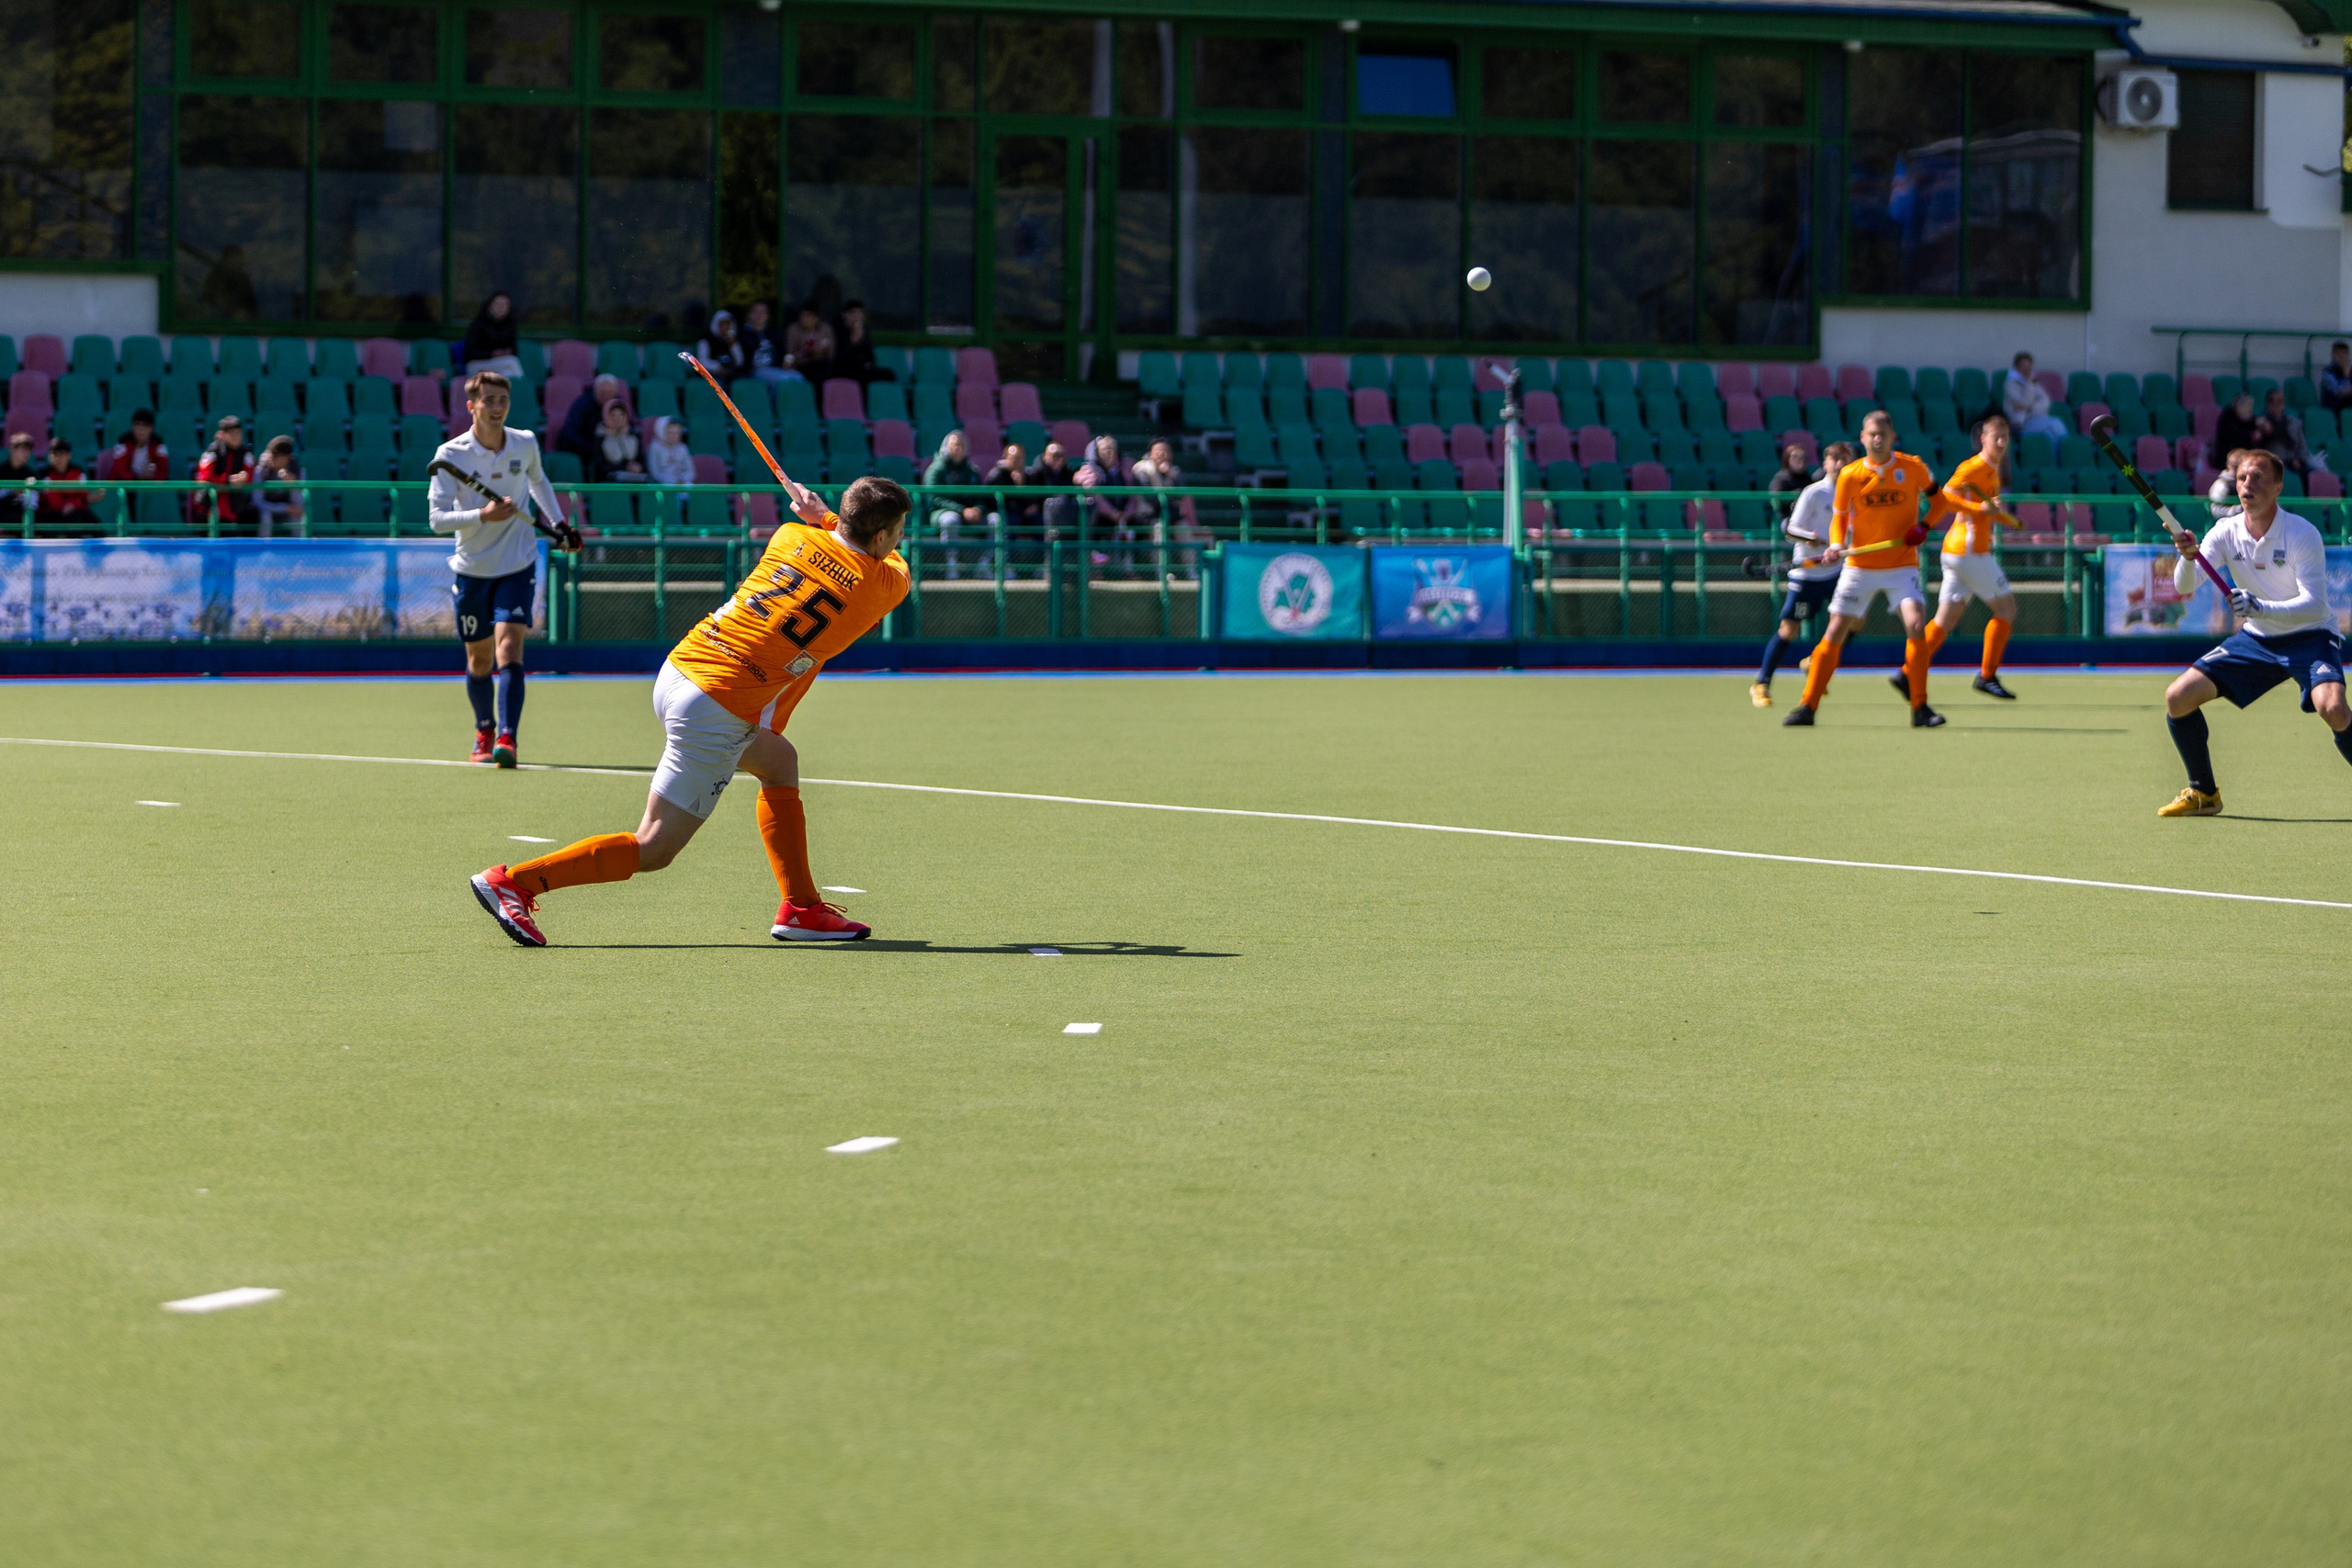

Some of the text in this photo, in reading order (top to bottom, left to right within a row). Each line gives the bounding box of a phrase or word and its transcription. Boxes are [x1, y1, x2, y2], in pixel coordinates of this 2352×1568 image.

[808, 551, 859, 591] SIZHUK
[460, 615, 478, 636] 19
[744, 563, 847, 649] 25
